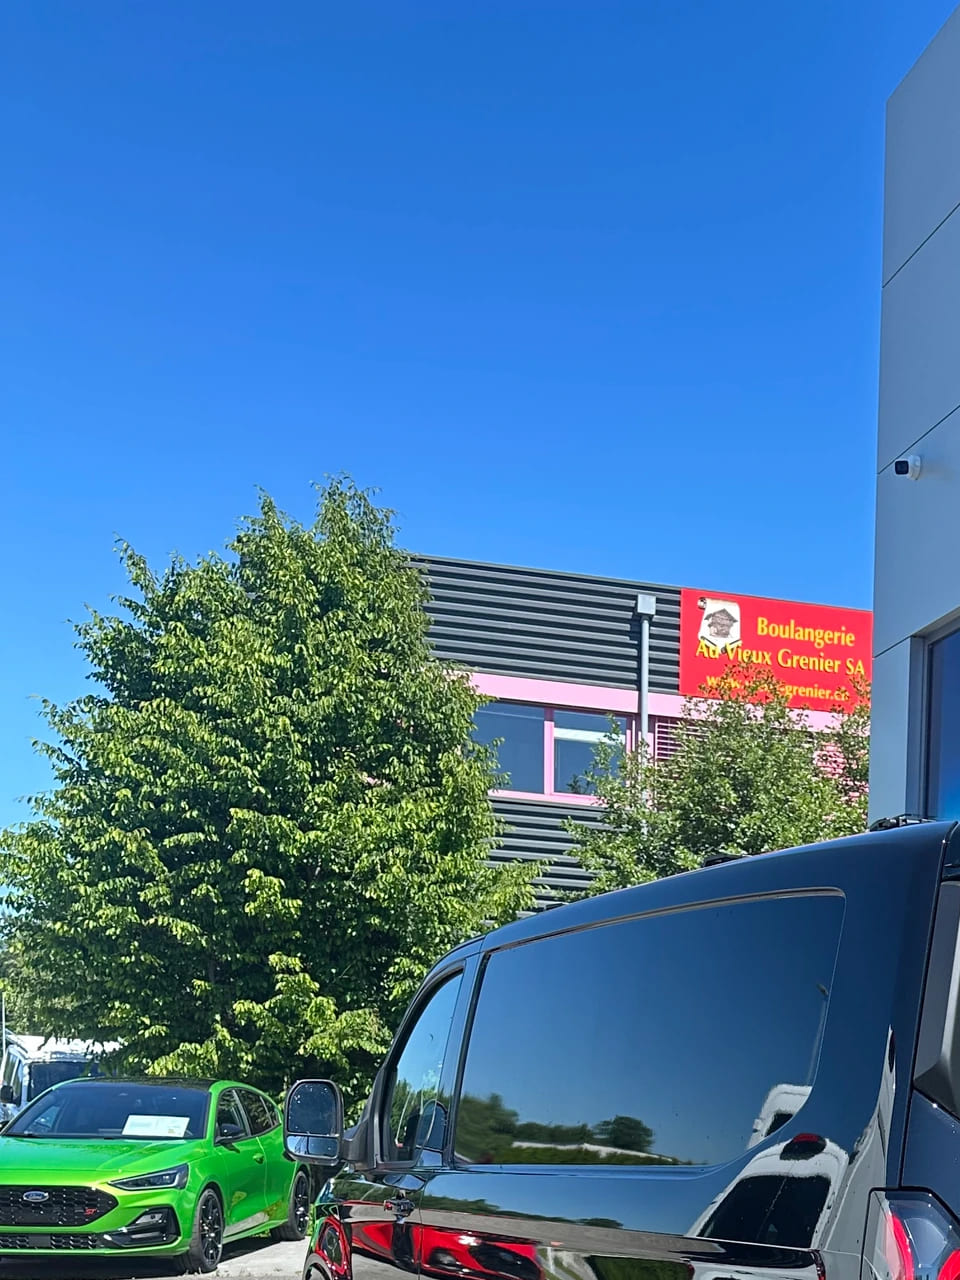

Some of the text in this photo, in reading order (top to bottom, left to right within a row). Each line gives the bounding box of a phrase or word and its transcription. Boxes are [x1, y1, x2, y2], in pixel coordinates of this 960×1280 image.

[757, 616, 855, 649] Boulangerie
[695, 639, 865, 675] Au Vieux Grenier SA
